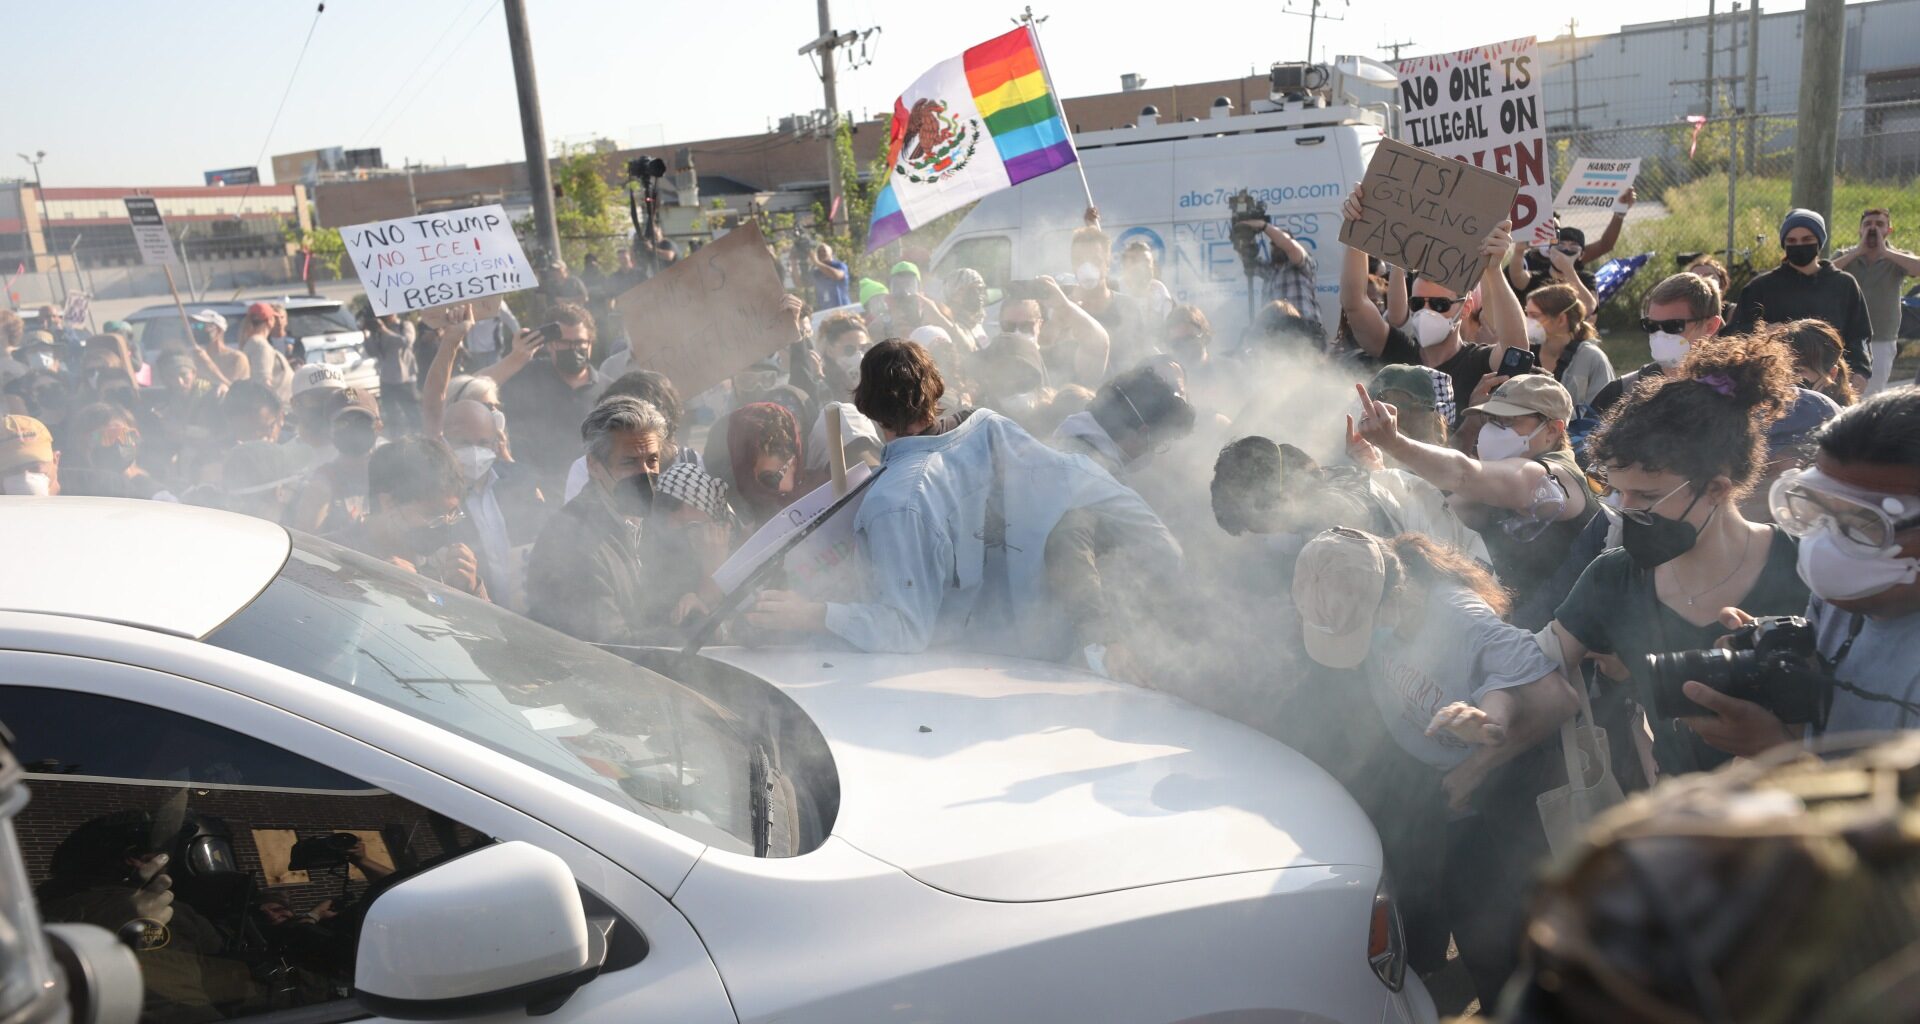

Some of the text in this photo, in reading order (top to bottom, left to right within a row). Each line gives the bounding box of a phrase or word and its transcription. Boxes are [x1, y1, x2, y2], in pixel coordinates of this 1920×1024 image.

[1400, 55, 1531, 114] NO ONE IS
[1405, 95, 1538, 148] ILLEGAL ON
[1587, 162, 1632, 172] HANDS OFF
[1372, 181, 1478, 236] GIVING
[1567, 195, 1615, 208] CHICAGO
[365, 214, 500, 248] NO TRUMP
[377, 250, 405, 270] NO
[387, 271, 415, 289] NO
[403, 272, 521, 309] RESIST!!!
